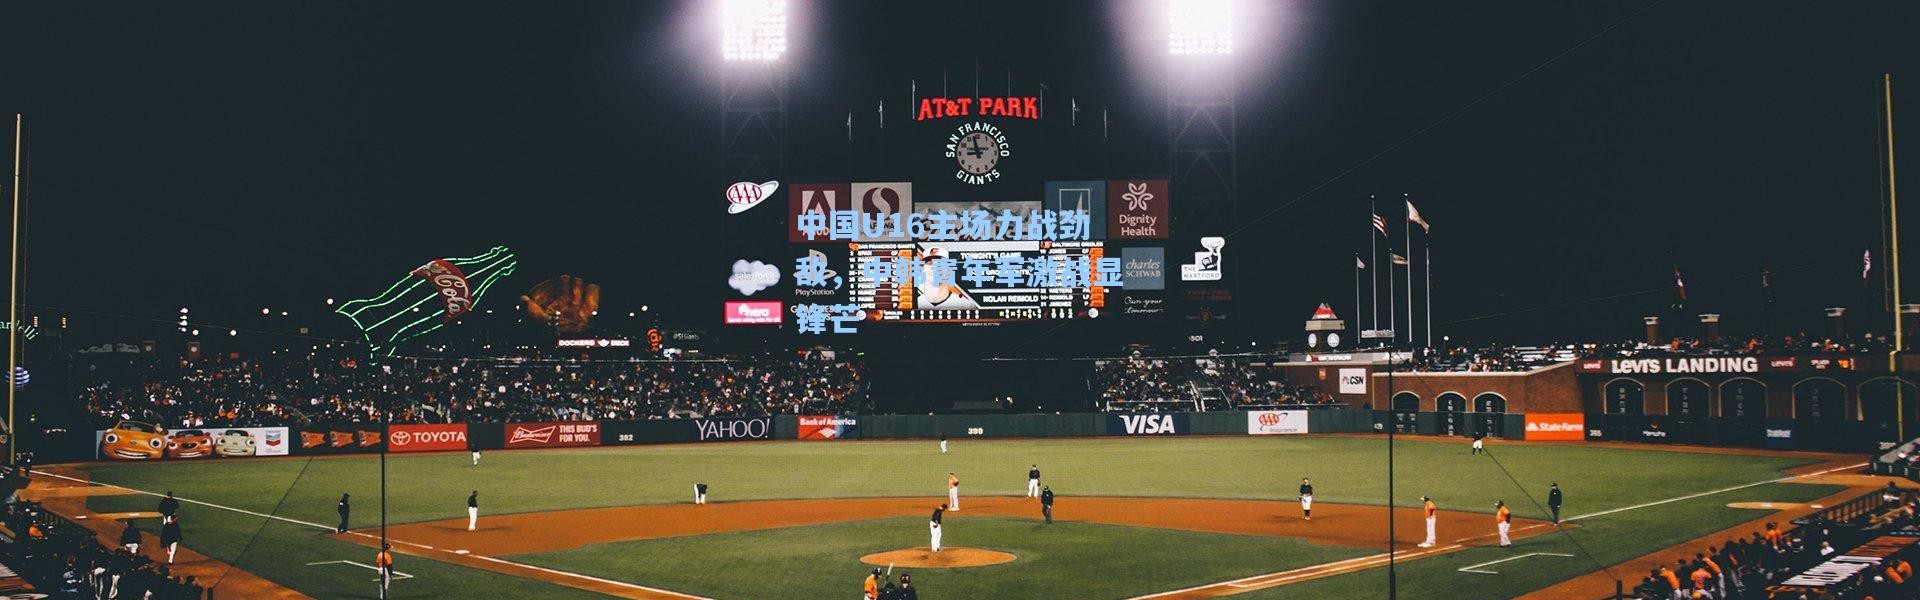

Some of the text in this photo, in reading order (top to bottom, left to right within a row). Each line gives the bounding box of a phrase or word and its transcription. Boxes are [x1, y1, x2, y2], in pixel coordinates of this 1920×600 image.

[917, 97, 1038, 121] AT&T PARK
[946, 121, 1010, 158] SAN FRANCISCO
[956, 169, 1000, 185] GIANTS
[729, 183, 761, 204] AAA
[1119, 214, 1157, 229] Dignity
[1121, 227, 1156, 237] Health
[1125, 258, 1161, 270] charles
[734, 271, 776, 282] salesforce
[1125, 270, 1162, 278] SCHWAB
[435, 274, 471, 315] Cola
[795, 288, 835, 297] PlayStation
[983, 295, 1039, 303] NOLAN REIMOLD
[558, 339, 630, 347] DOCKERS DECK
[1665, 357, 1759, 374] LANDING
[1349, 375, 1365, 385] CSN
[800, 417, 857, 427] Bank of America
[1119, 414, 1176, 434] VISA
[1260, 413, 1279, 426] AAA
[514, 430, 552, 439] Budweiser
[559, 424, 598, 433] THIS BUD'S
[695, 418, 770, 440] YAHOO!
[413, 430, 467, 443] TOYOTA
[559, 434, 574, 443] FOR
